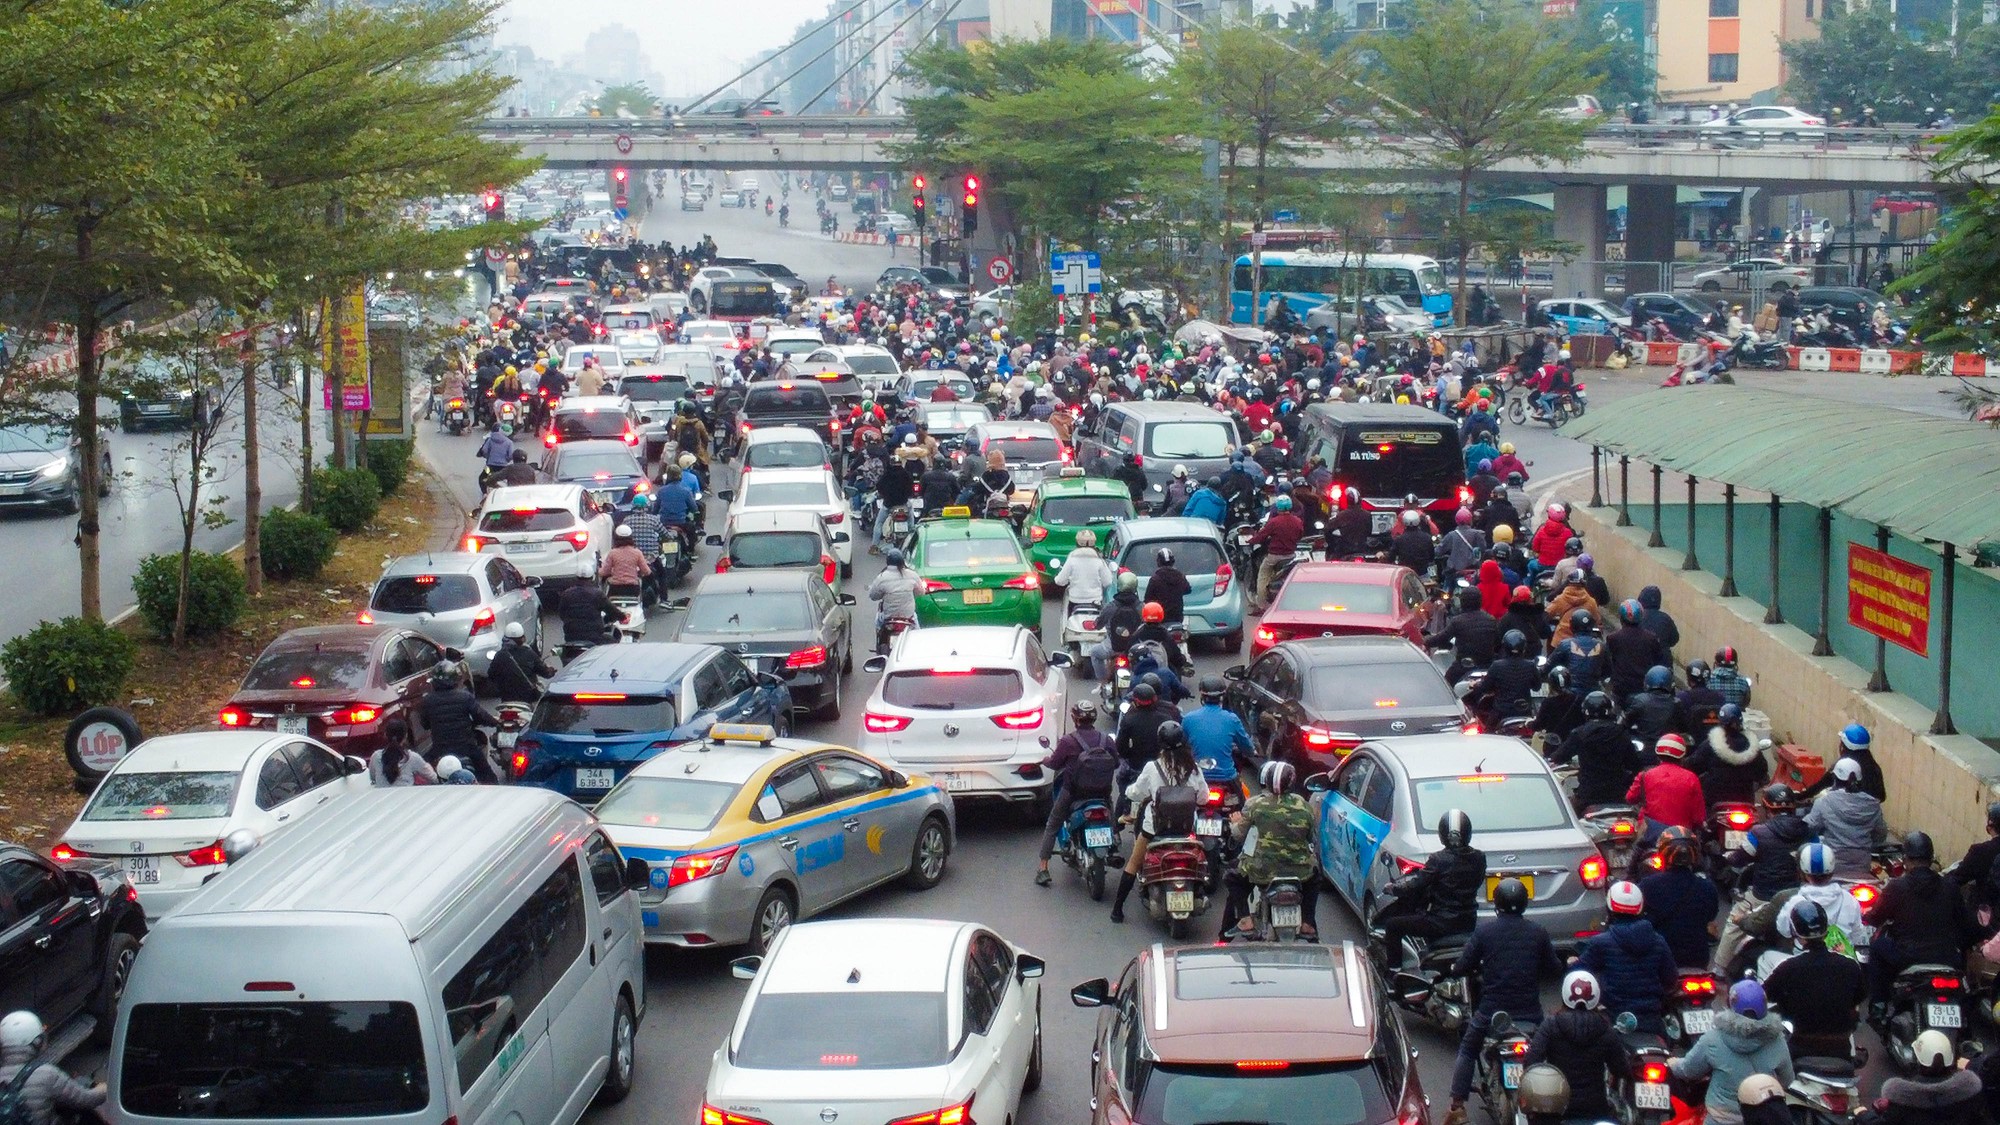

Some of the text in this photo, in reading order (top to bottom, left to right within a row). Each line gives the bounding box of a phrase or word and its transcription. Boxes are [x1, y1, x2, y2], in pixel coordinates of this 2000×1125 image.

[81, 728, 123, 756] LỐP
[587, 769, 604, 778] 34A
[130, 858, 150, 869] 30A
